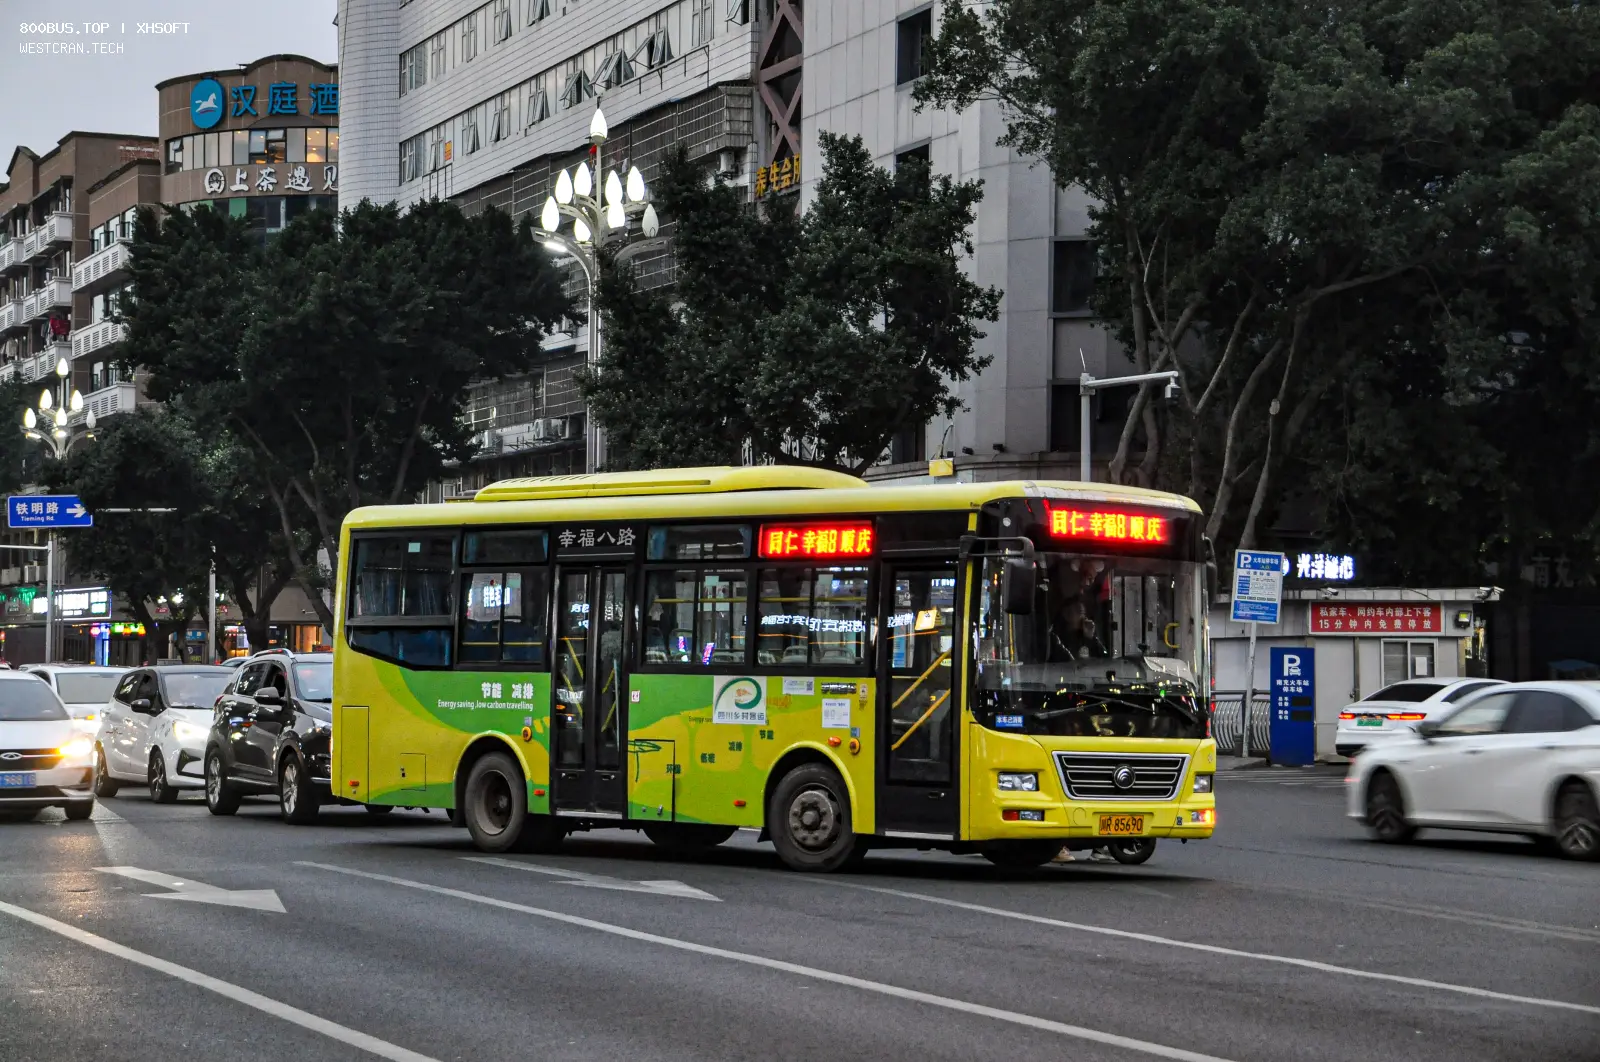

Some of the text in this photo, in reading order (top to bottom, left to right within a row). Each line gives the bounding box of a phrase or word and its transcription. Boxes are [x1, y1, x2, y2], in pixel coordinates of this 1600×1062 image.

[231, 82, 338, 116] 汉庭酒
[16, 501, 59, 515] 铁明路
[1053, 510, 1085, 535] 同仁
[558, 527, 636, 548] 幸福八路
[768, 530, 799, 554] 同仁
[1319, 606, 1432, 617] 私家车、网约车内部上下客
[1283, 654, 1301, 677] P
[481, 682, 534, 700] 节能 减排
[1276, 679, 1310, 687] 南充火车站
[1282, 686, 1303, 694] 停车场
[438, 699, 456, 710] Energy
[507, 703, 534, 712] travelling
